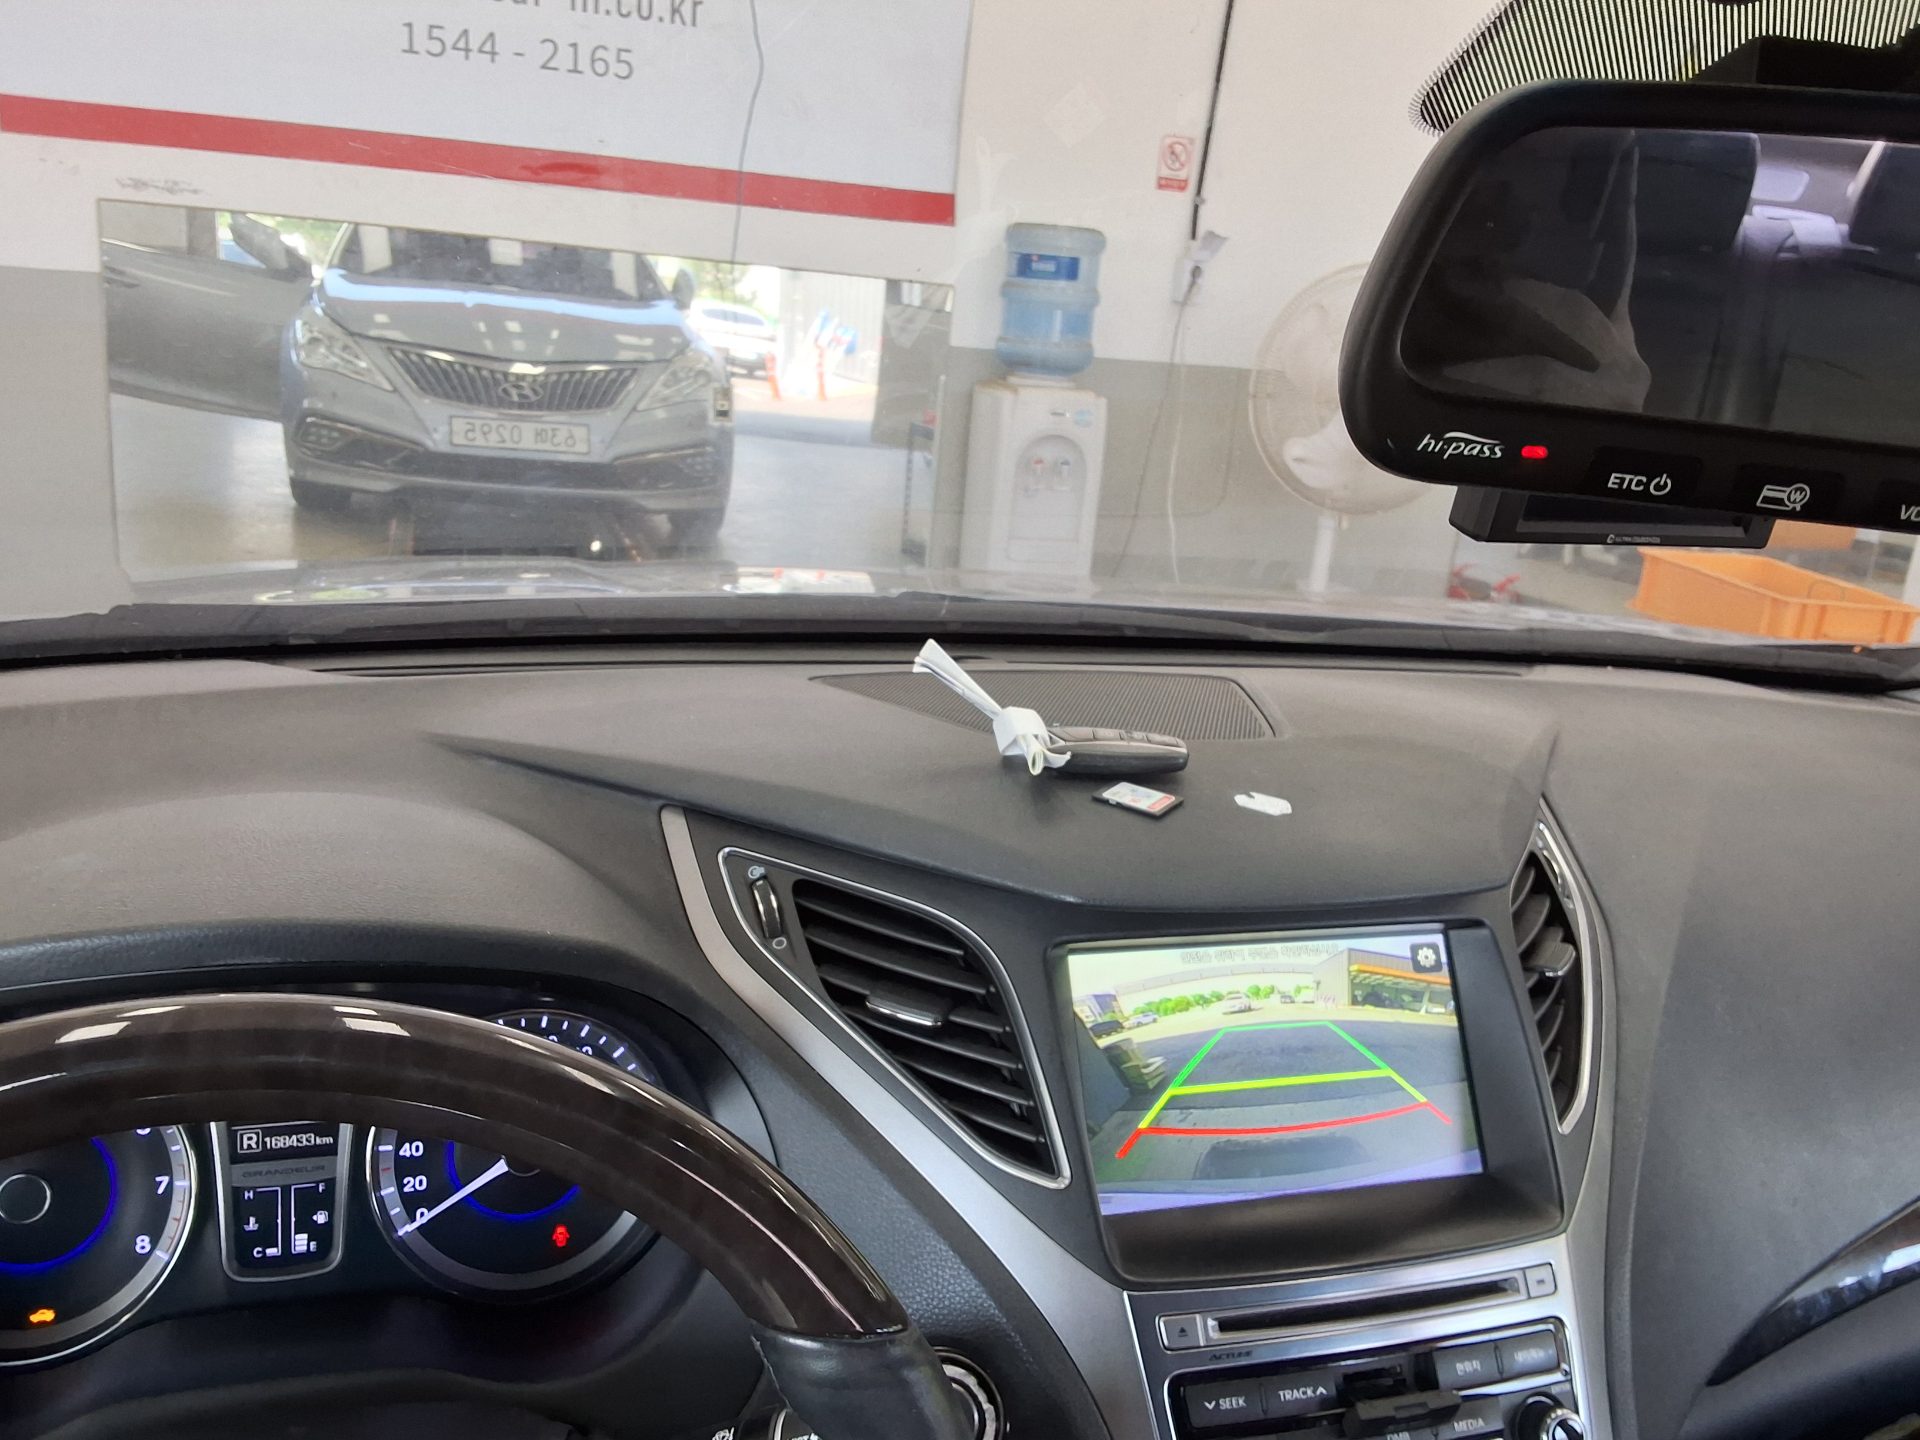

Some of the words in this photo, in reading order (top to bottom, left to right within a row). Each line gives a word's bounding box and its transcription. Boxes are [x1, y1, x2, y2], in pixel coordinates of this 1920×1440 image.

[539, 38, 634, 80] 2165
[1607, 473, 1647, 491] ETC
[242, 1133, 257, 1149] R
[399, 1140, 424, 1157] 40
[242, 1165, 325, 1178] GRANDEUR
[155, 1175, 170, 1195] 7
[319, 1182, 326, 1193] F
[403, 1175, 428, 1192] 20
[244, 1190, 254, 1200] H
[135, 1234, 151, 1254] 8
[309, 1241, 317, 1252] E
[253, 1247, 263, 1258] C
[1278, 1386, 1315, 1402] TRACK
[1219, 1396, 1247, 1410] SEEK
[1454, 1417, 1485, 1432] MEDIA
